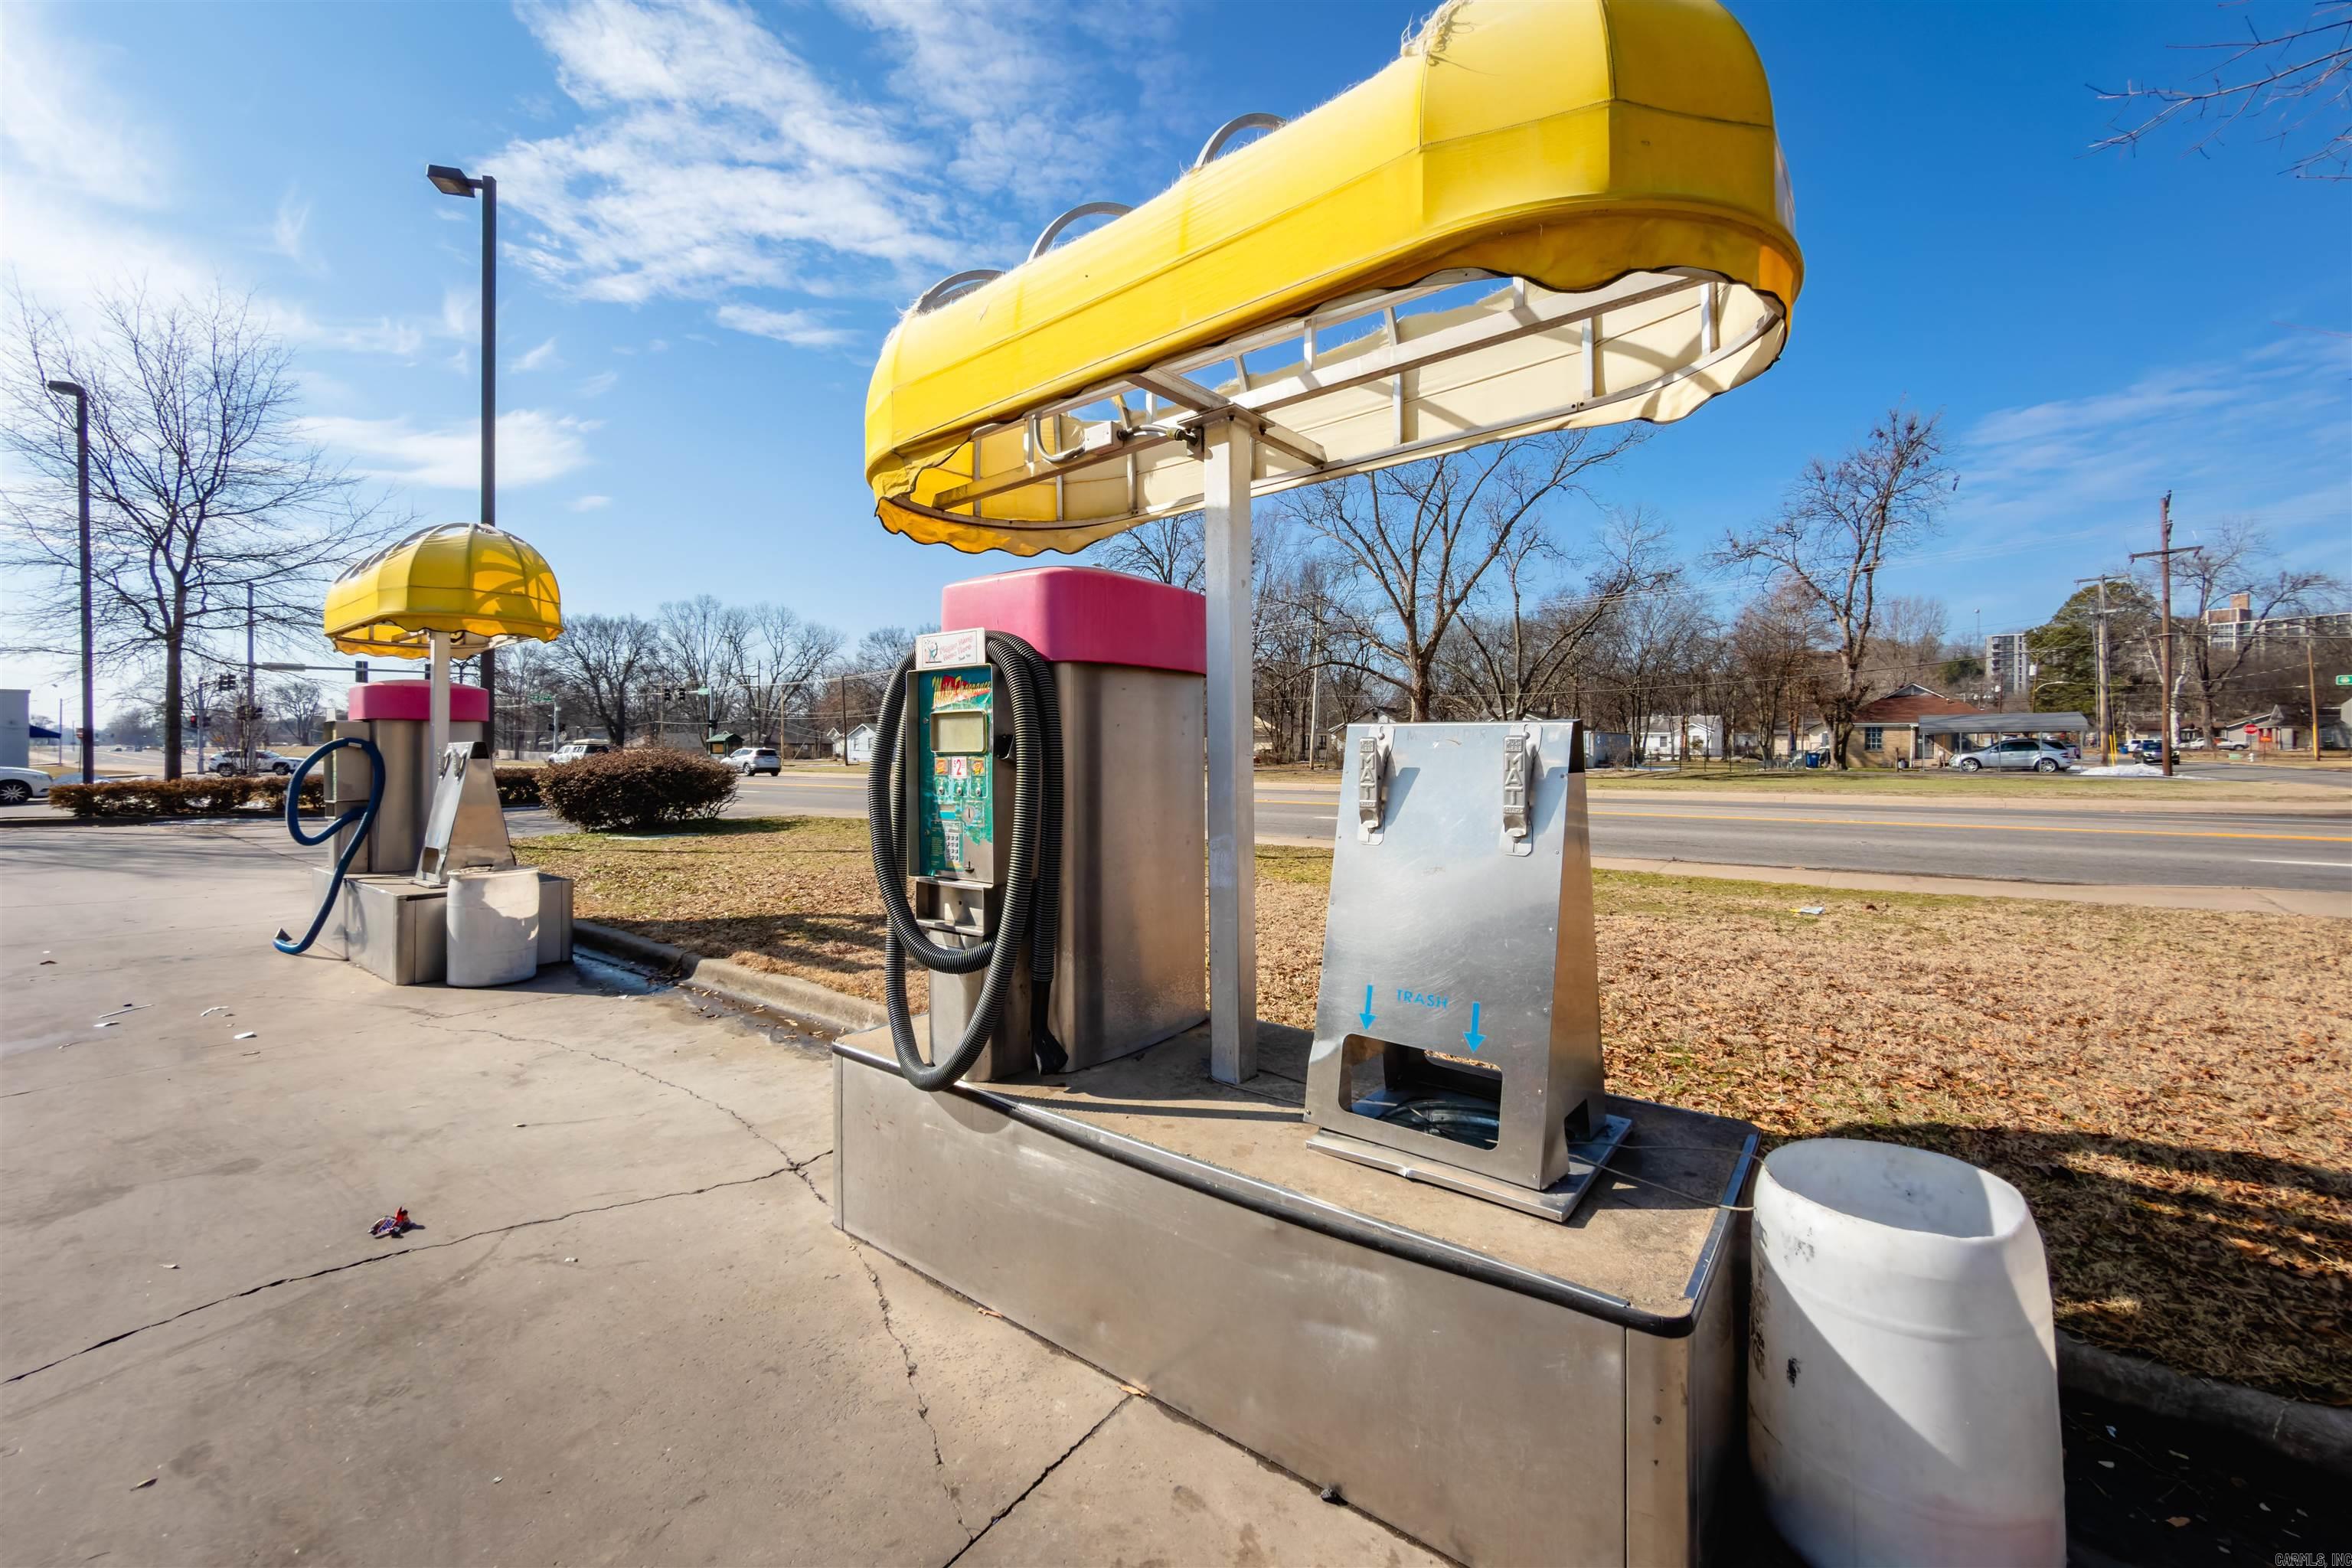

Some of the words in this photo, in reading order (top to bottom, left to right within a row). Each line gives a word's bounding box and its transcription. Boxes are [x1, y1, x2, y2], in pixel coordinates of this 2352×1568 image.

[1360, 753, 1376, 801] MAT
[1504, 753, 1524, 805] MAT
[1396, 989, 1448, 1008] TRASH
